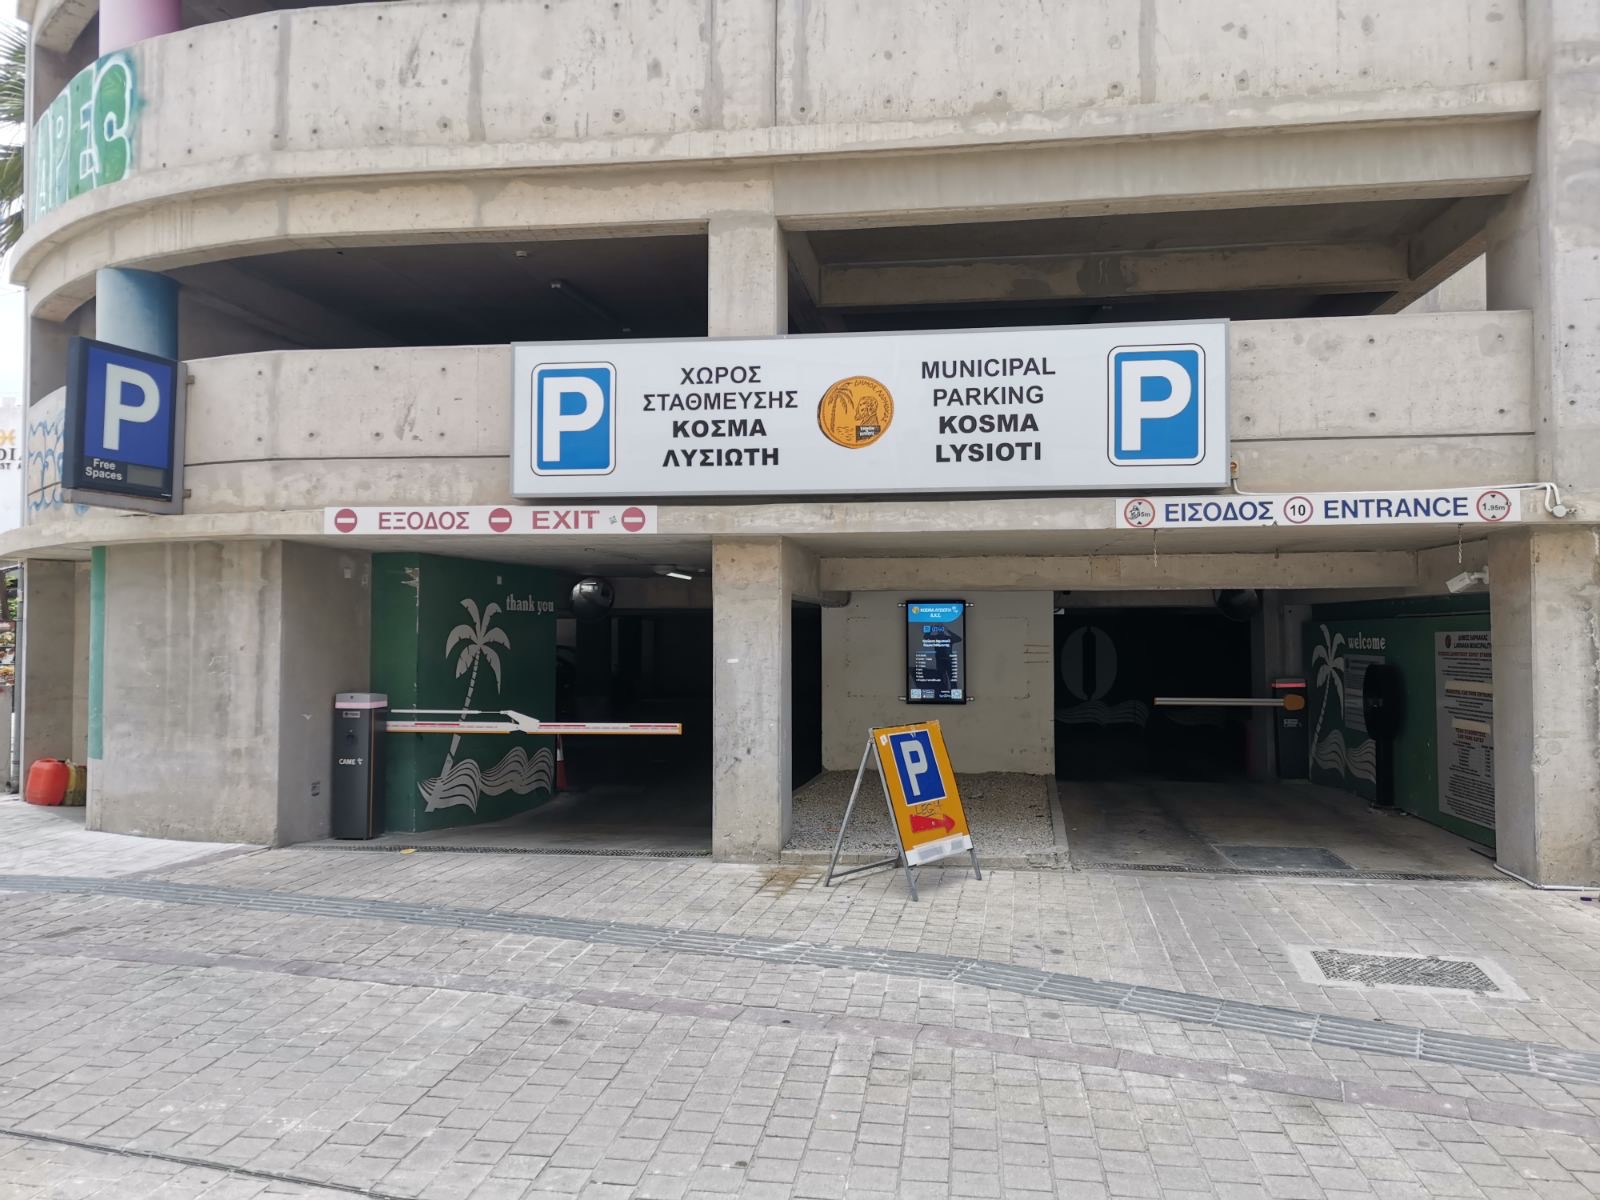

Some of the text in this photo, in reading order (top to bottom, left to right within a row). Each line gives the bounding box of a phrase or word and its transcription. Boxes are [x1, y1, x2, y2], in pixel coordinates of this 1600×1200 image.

[680, 365, 762, 386] ΧΩΡΟΣ
[921, 357, 1056, 379] MUNICIPAL
[103, 363, 160, 451] P
[643, 390, 798, 412] ΣΤΑΘΜΕΥΣΗΣ
[933, 385, 1044, 407] PARKING
[1121, 359, 1192, 451] P
[543, 376, 604, 462] P
[672, 418, 767, 439] ΚΟΣΜΑ
[938, 413, 1039, 435] KOSMA
[662, 447, 780, 468] ΛΥΣΙΩΤΗ
[935, 442, 1042, 463] LYSIOTI
[85, 466, 123, 481] Spaces
[93, 458, 116, 471] Free
[378, 510, 600, 530] ΕΞΟΔΟΣ EXIT
[1165, 501, 1274, 522] ΕΙΣΟΔΟΣ
[1289, 504, 1306, 517] 10
[1324, 497, 1468, 519] ENTRANCE
[506, 593, 554, 615] thank you
[1347, 631, 1386, 650] welcome
[338, 758, 356, 766] CAME
[900, 740, 928, 796] P
